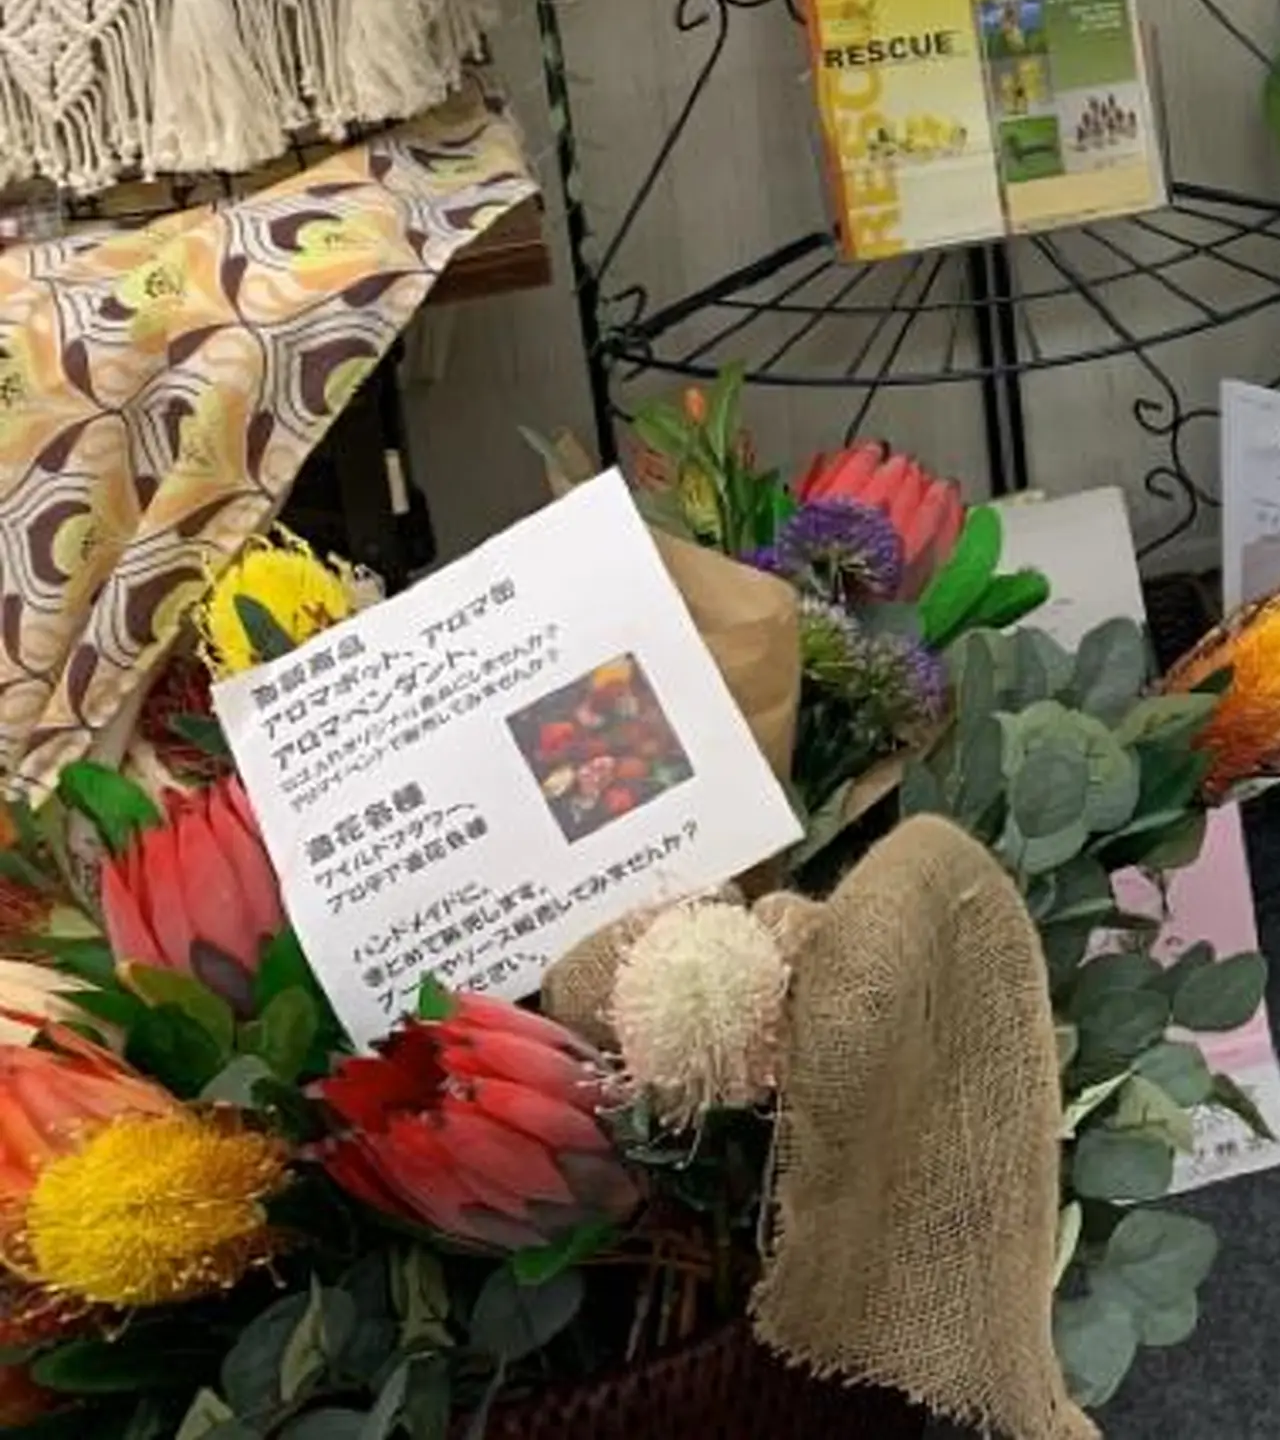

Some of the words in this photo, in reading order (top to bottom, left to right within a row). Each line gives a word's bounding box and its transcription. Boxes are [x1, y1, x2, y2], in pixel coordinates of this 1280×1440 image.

[823, 31, 955, 68] RESCUE
[304, 782, 427, 864] 造花各種
[377, 821, 700, 1015] ブーやリース販売してみませんか？
